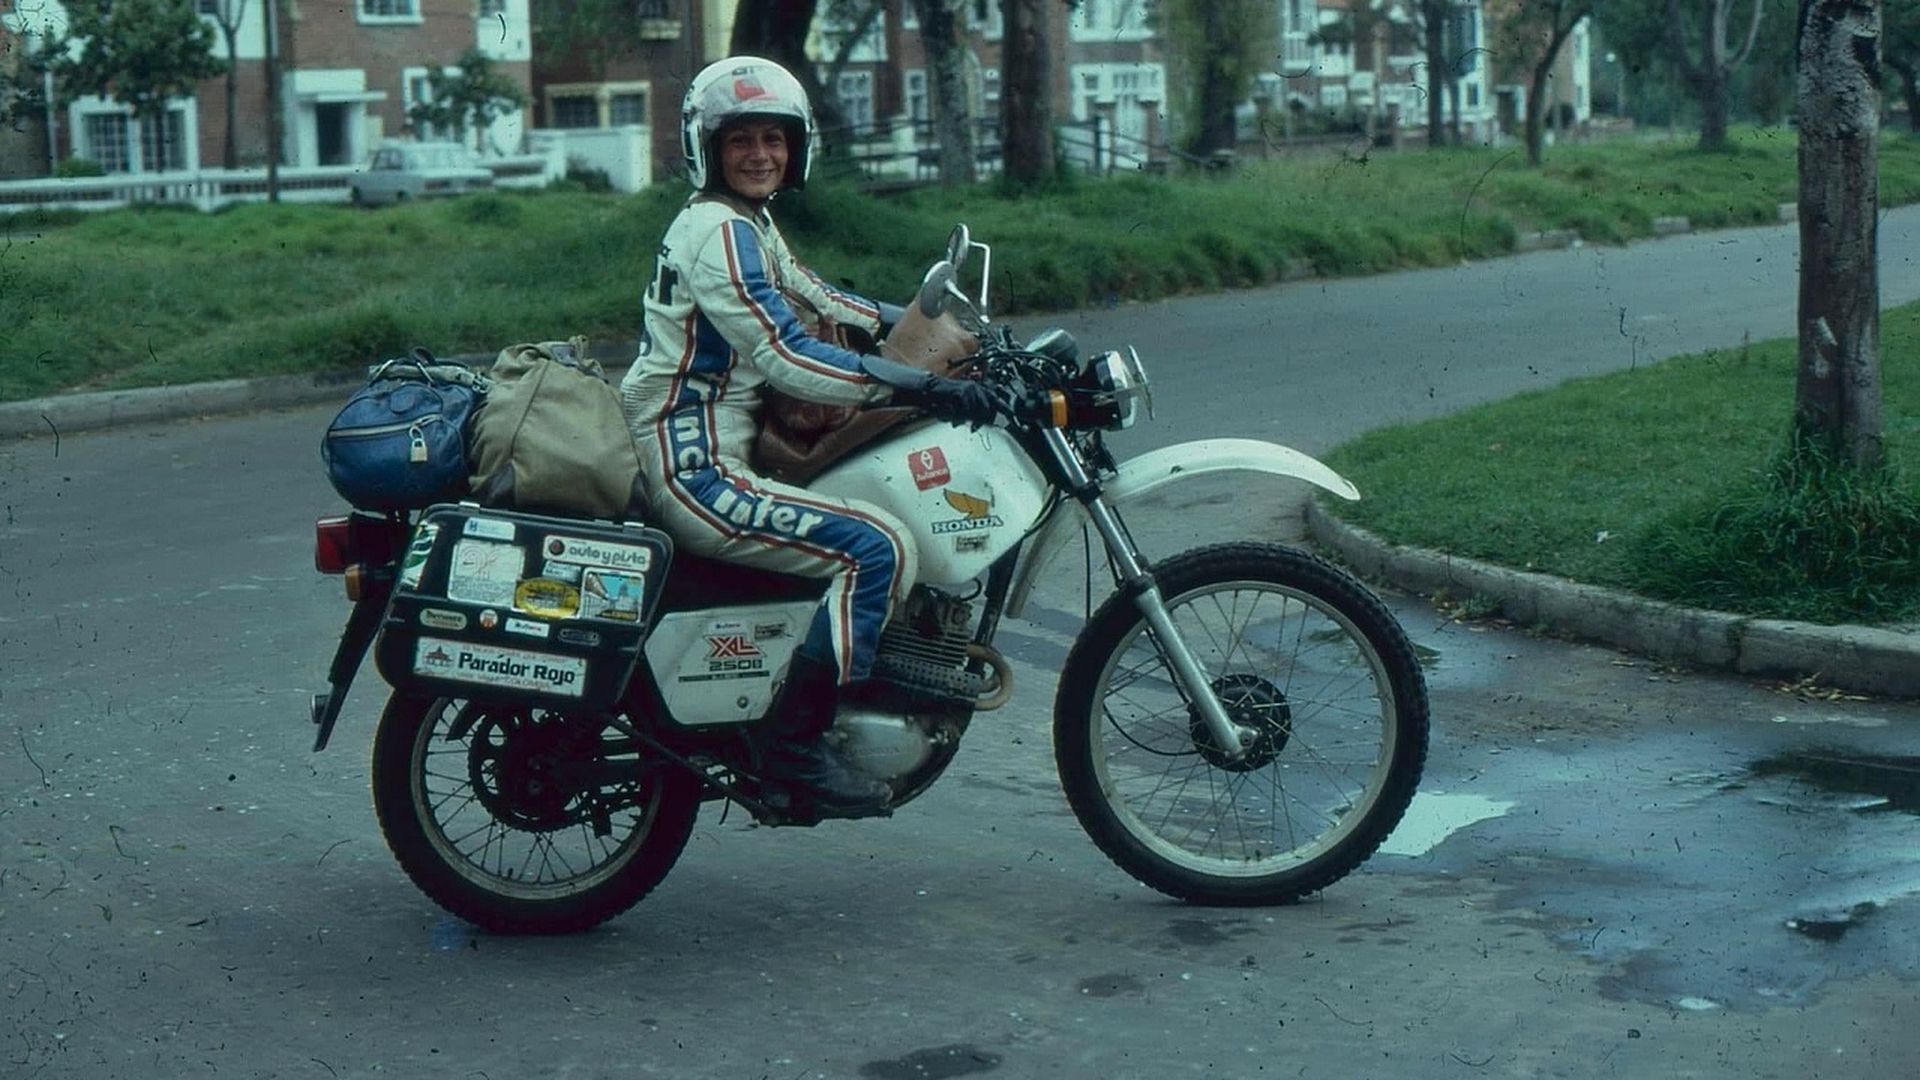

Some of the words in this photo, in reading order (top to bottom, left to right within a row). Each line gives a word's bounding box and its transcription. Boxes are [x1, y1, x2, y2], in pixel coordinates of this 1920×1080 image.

[931, 515, 1004, 534] HONDA
[569, 546, 600, 559] auto
[602, 551, 611, 565] y
[612, 550, 646, 565] pista
[707, 634, 765, 657] XL
[533, 664, 576, 686] Rojo
